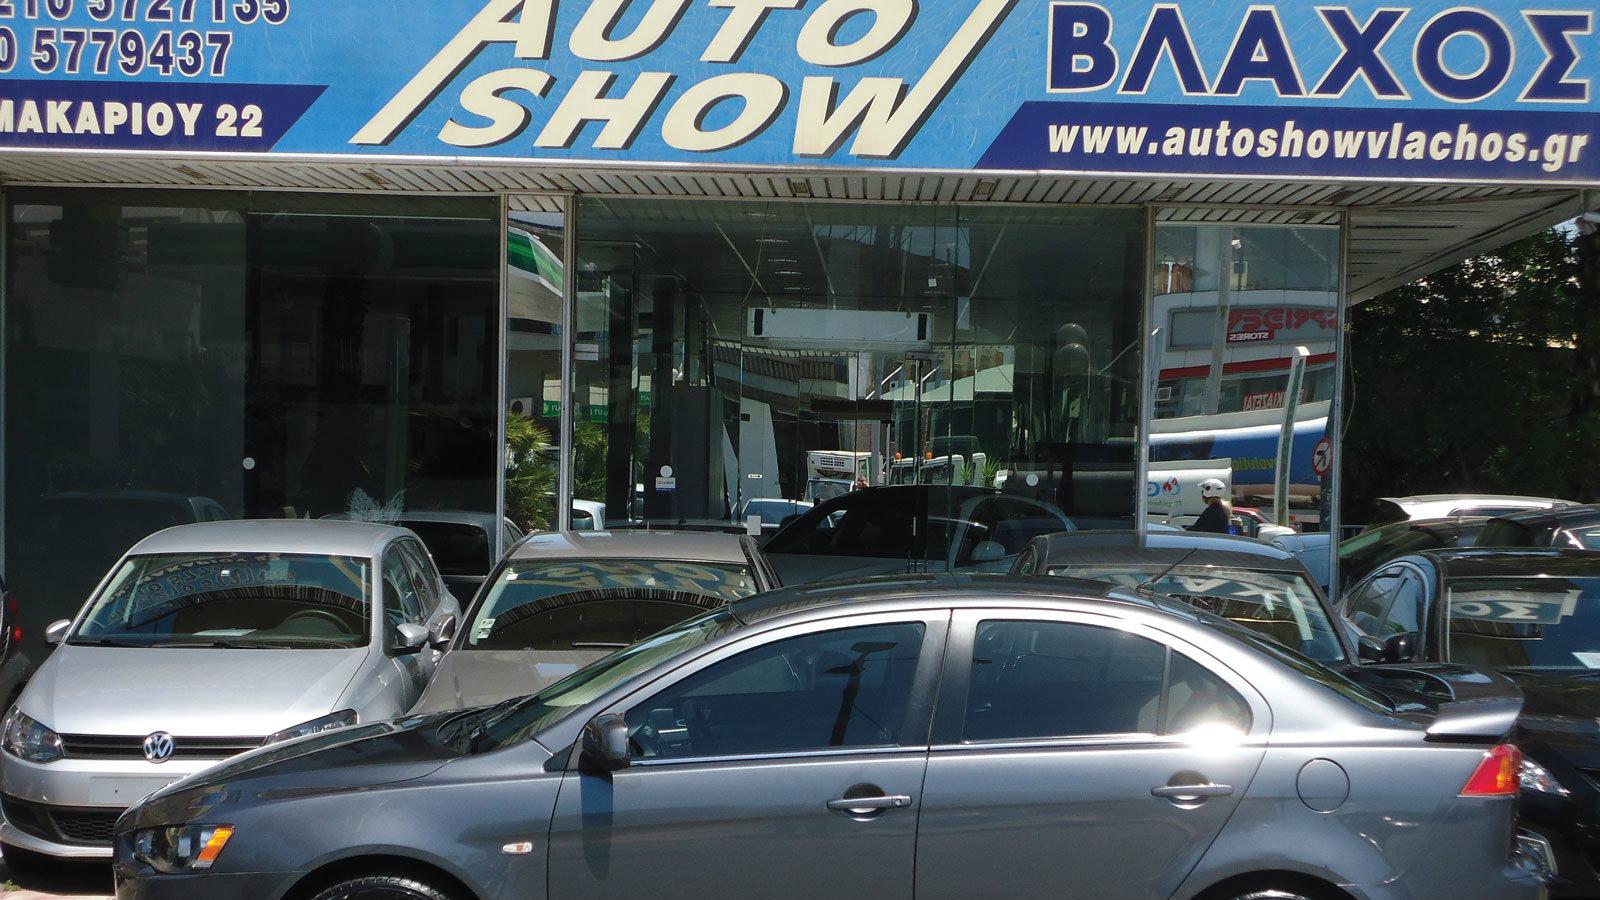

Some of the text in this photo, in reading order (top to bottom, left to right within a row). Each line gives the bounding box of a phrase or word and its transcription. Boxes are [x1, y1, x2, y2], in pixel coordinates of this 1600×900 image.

[31, 27, 233, 77] 5779437
[1046, 0, 1593, 103] ΒΛΑΧΟΣ
[215, 104, 263, 137] 22
[437, 68, 950, 160] SHOW
[1048, 120, 1588, 172] www.autoshowvlachos.gr
